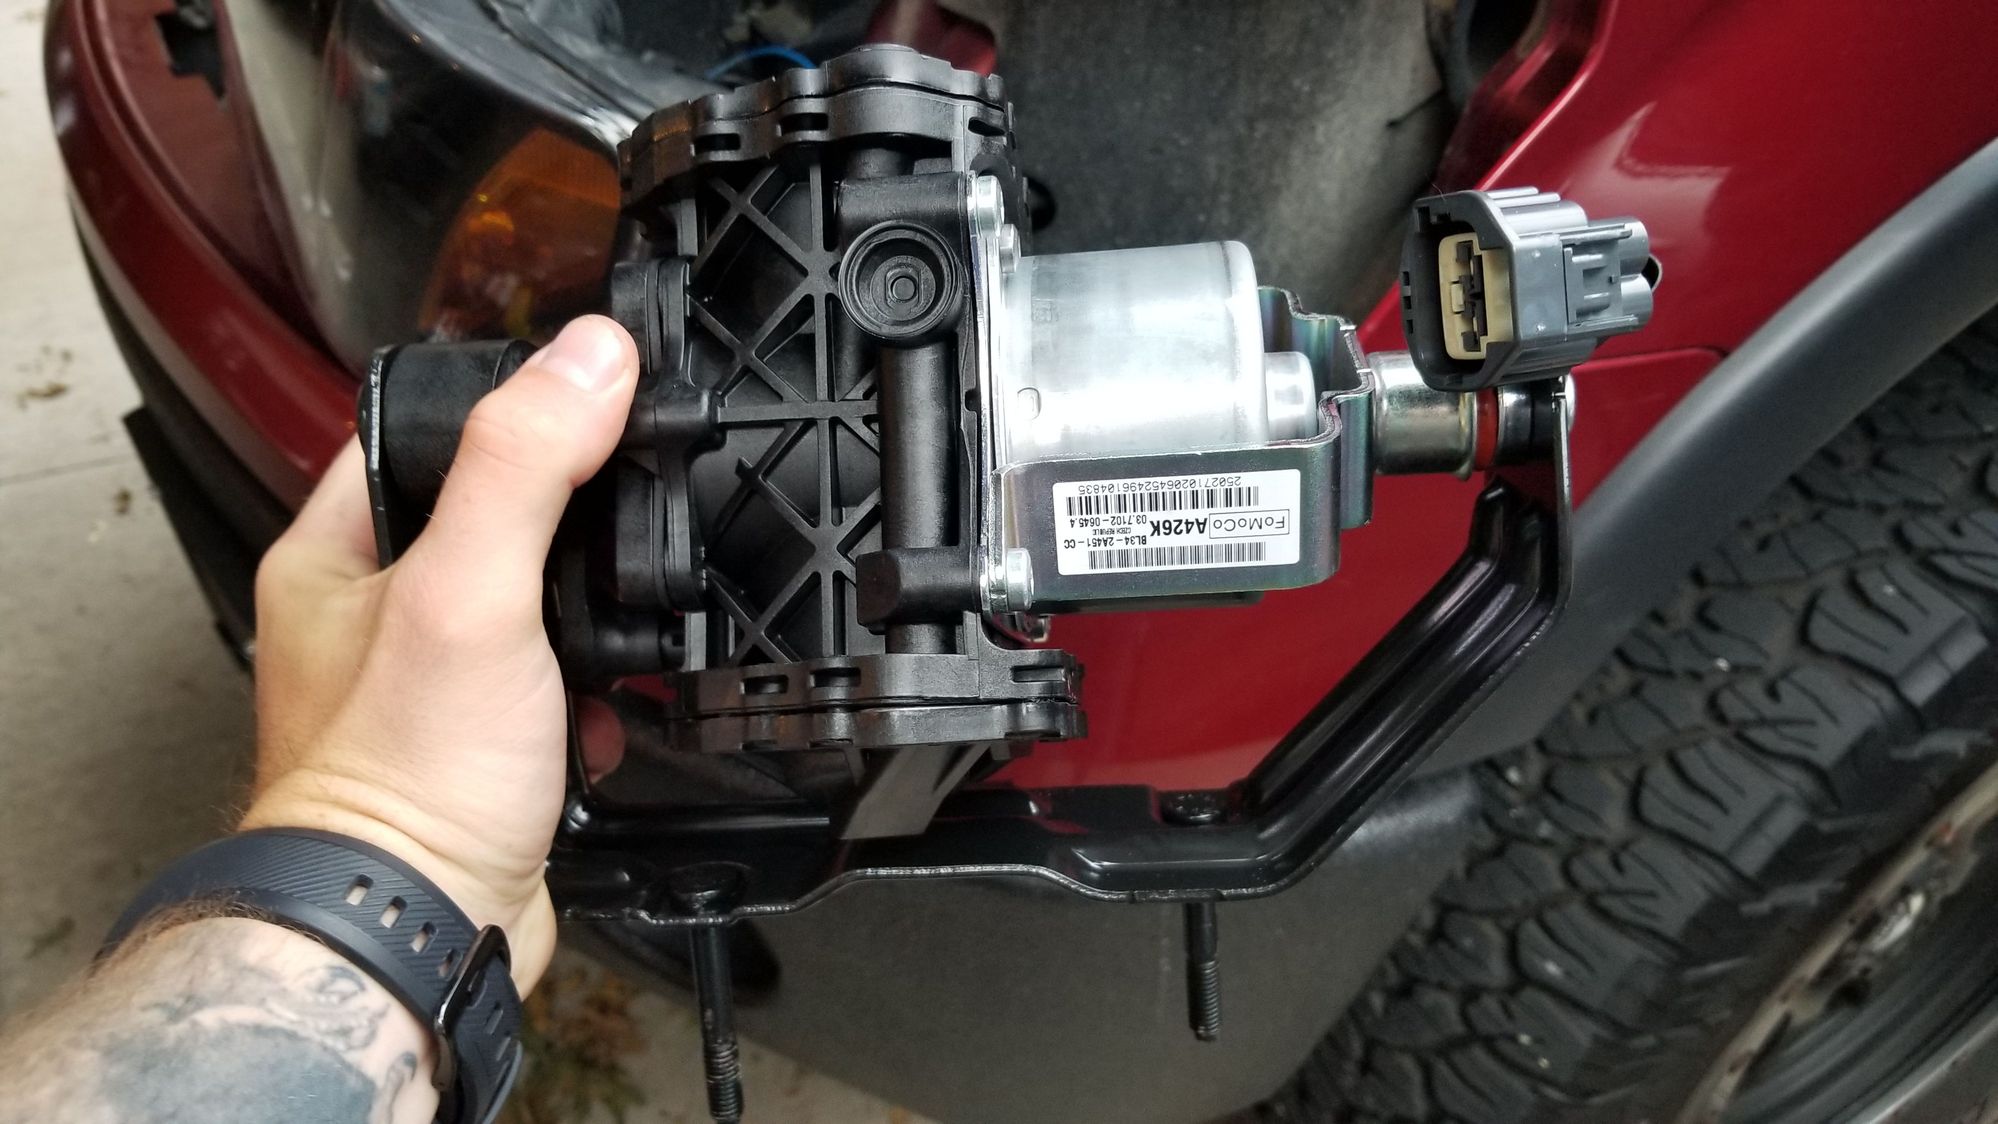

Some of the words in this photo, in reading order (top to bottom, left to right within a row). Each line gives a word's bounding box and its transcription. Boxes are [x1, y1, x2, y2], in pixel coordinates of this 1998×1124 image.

[1078, 476, 1241, 495] 2502710206452496104835
[1115, 527, 1132, 535] CZECH
[1150, 517, 1208, 537] A426K
[1213, 515, 1285, 531] FoMoCo
[1092, 528, 1115, 536] REPUBLIC
